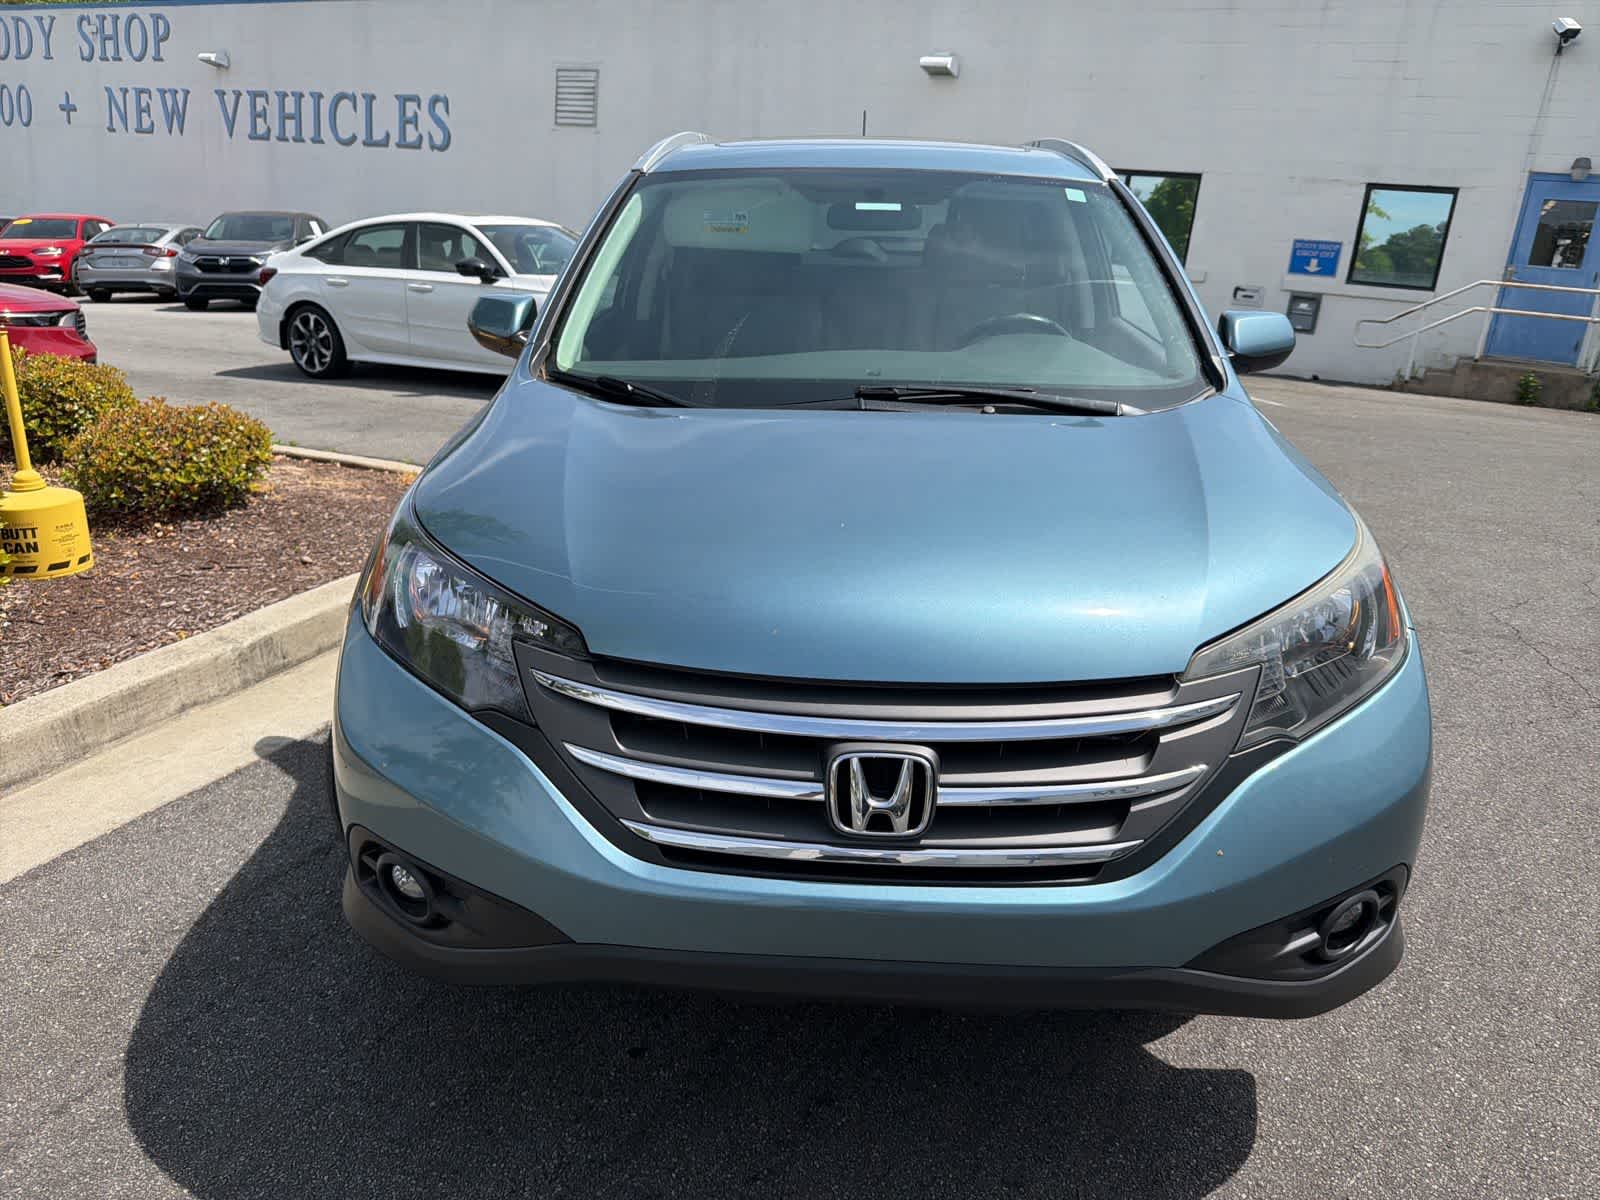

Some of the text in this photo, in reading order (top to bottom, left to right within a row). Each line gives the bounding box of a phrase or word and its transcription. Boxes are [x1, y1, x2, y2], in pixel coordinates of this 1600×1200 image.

[76, 13, 170, 62] SHOP
[58, 91, 77, 125] +
[104, 86, 191, 136] NEW
[214, 89, 452, 152] VEHICLES
[1, 527, 38, 539] BUTT
[3, 542, 39, 554] CAN
